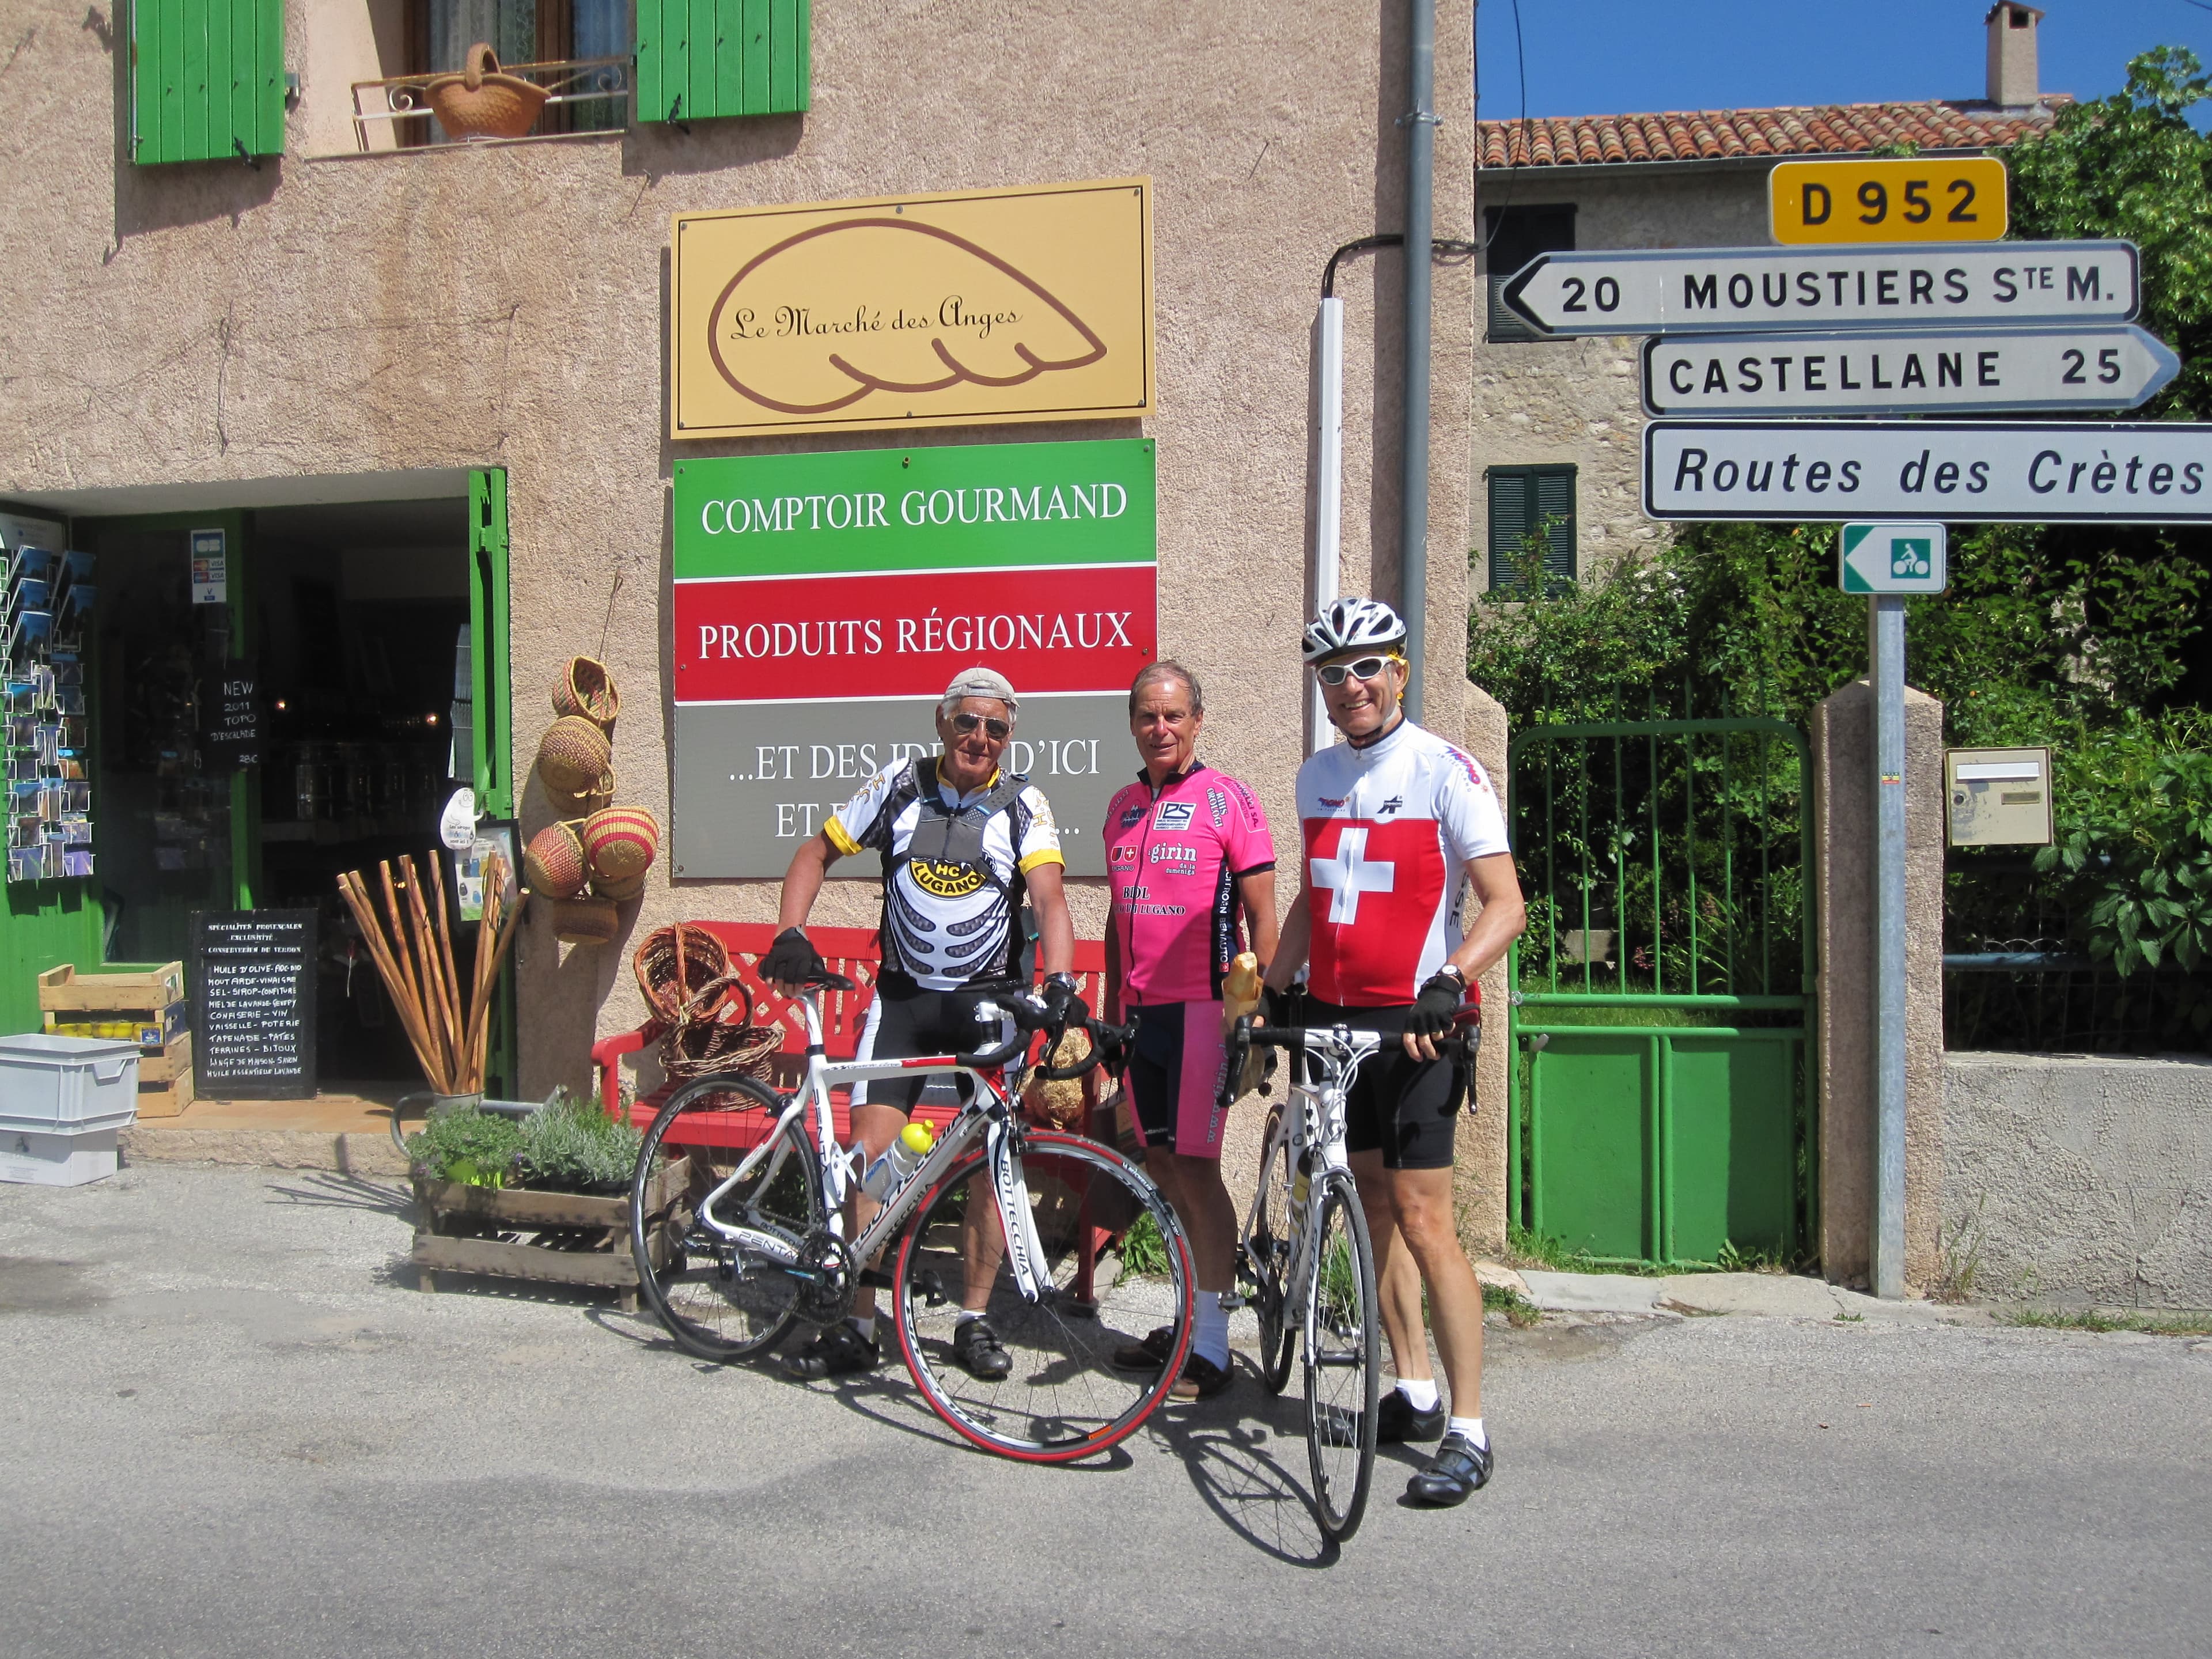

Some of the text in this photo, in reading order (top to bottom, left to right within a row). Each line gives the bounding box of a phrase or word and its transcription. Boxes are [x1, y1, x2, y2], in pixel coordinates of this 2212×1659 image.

[1801, 179, 1979, 226] D 952
[1562, 276, 1622, 313] 20
[1684, 267, 1970, 310] MOUSTIERS
[2067, 266, 2115, 301] M.
[730, 295, 1023, 341] Le Marché des Anges
[1669, 349, 2122, 394] CASTELLANE 25
[1674, 447, 2204, 495] Routes des Crètes
[701, 482, 1128, 536] COMPTOIR GOURMAND
[699, 608, 1134, 660] PRODUITS RÉGIONAUX
[224, 681, 253, 696] NEW
[224, 702, 249, 712] 2011
[224, 714, 256, 726] TOPO
[809, 743, 877, 778] DES
[1009, 738, 1101, 775] D'ICI
[775, 804, 819, 838] ET
[914, 865, 980, 893] LUGANO
[936, 864, 960, 877] HC
[1139, 904, 1185, 915] LUGANO
[214, 965, 237, 974] HUILE
[261, 1020, 300, 1028] POTERIE
[209, 1034, 259, 1042] TAPENADE
[209, 1046, 251, 1055] TERRINES
[263, 1044, 296, 1053] BIJOUX
[210, 1058, 234, 1067] LINGE
[277, 1056, 298, 1064] SAVON
[207, 1069, 229, 1078] HUILE
[274, 1067, 301, 1075] LAVANDE
[1000, 1160, 1029, 1276] BOTTECCHIA
